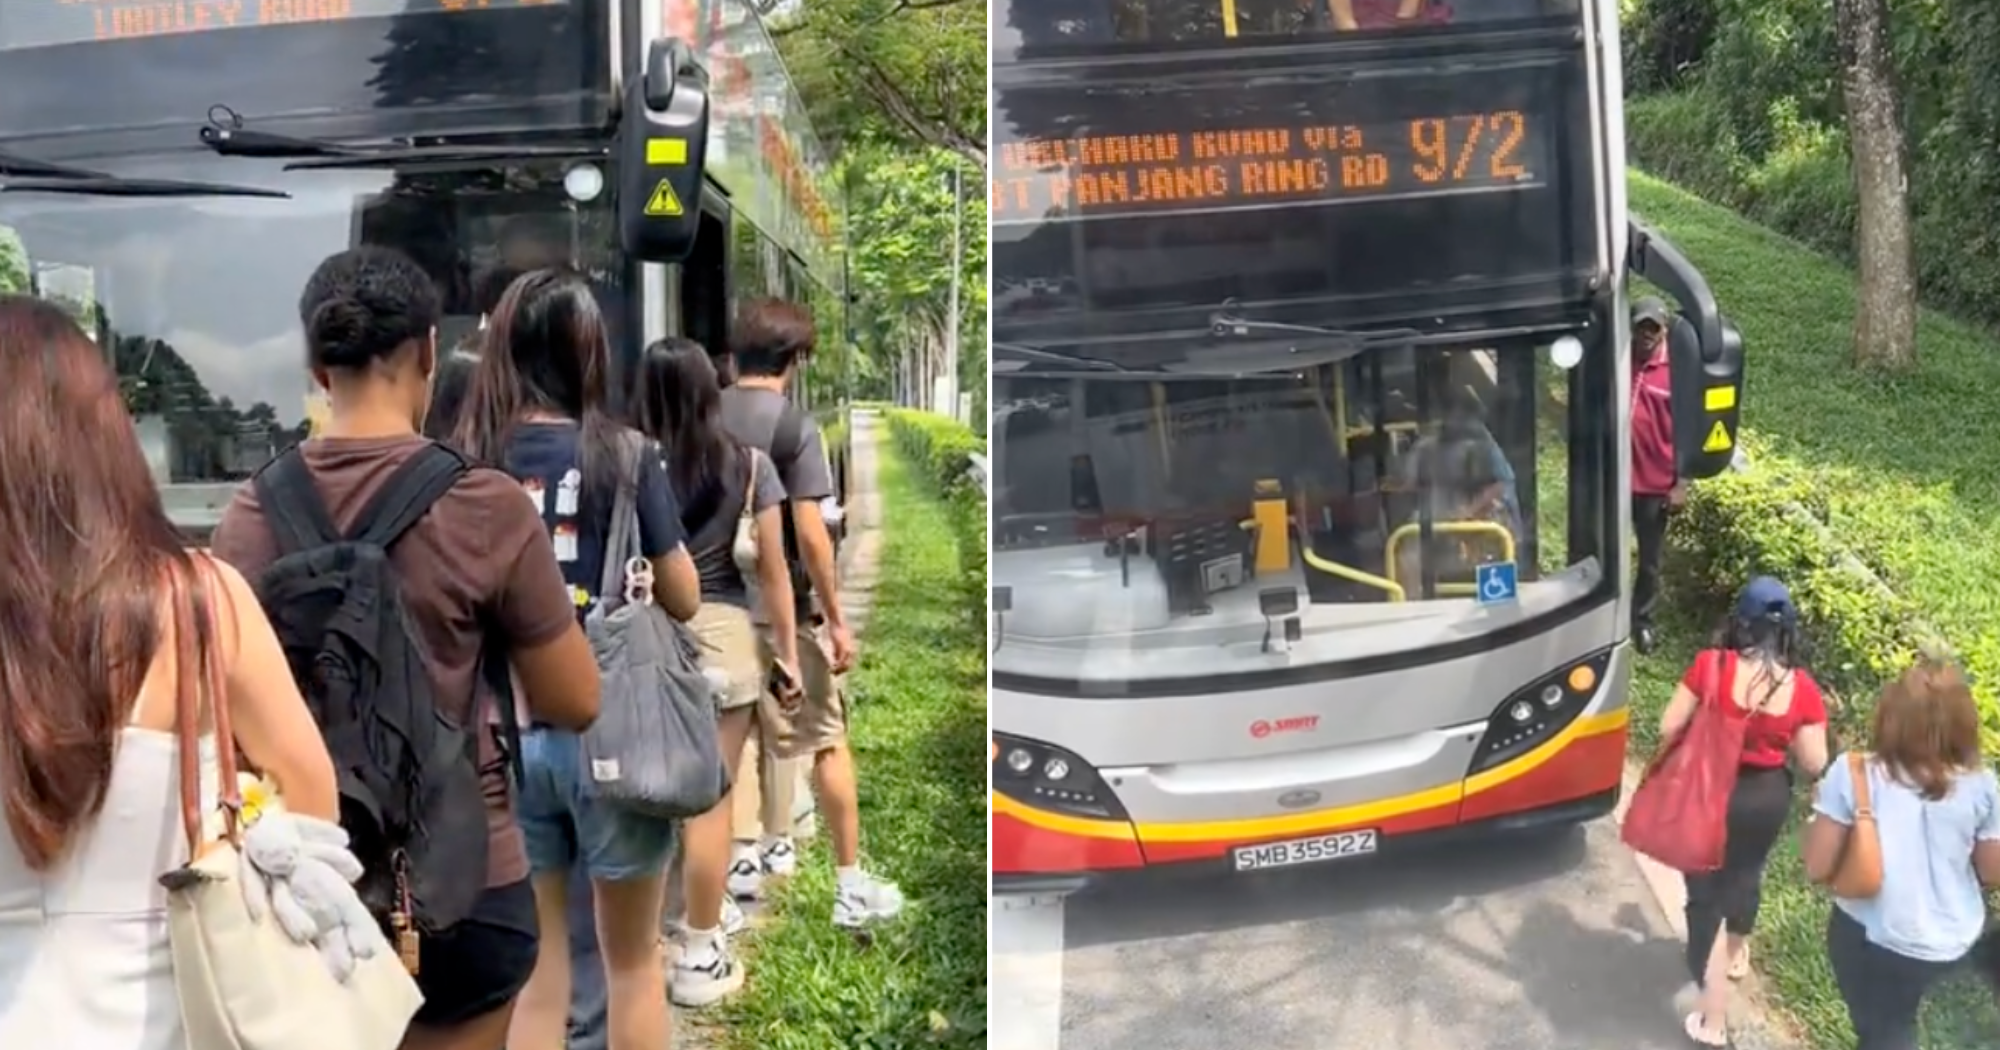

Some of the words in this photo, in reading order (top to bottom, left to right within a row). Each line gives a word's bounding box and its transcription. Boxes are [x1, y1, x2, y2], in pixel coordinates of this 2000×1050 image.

[1410, 106, 1525, 183] 972
[1050, 163, 1229, 208] PANJANG
[1241, 157, 1329, 195] RING
[1341, 152, 1389, 188] RD
[1238, 832, 1374, 870] SMB3592Z
